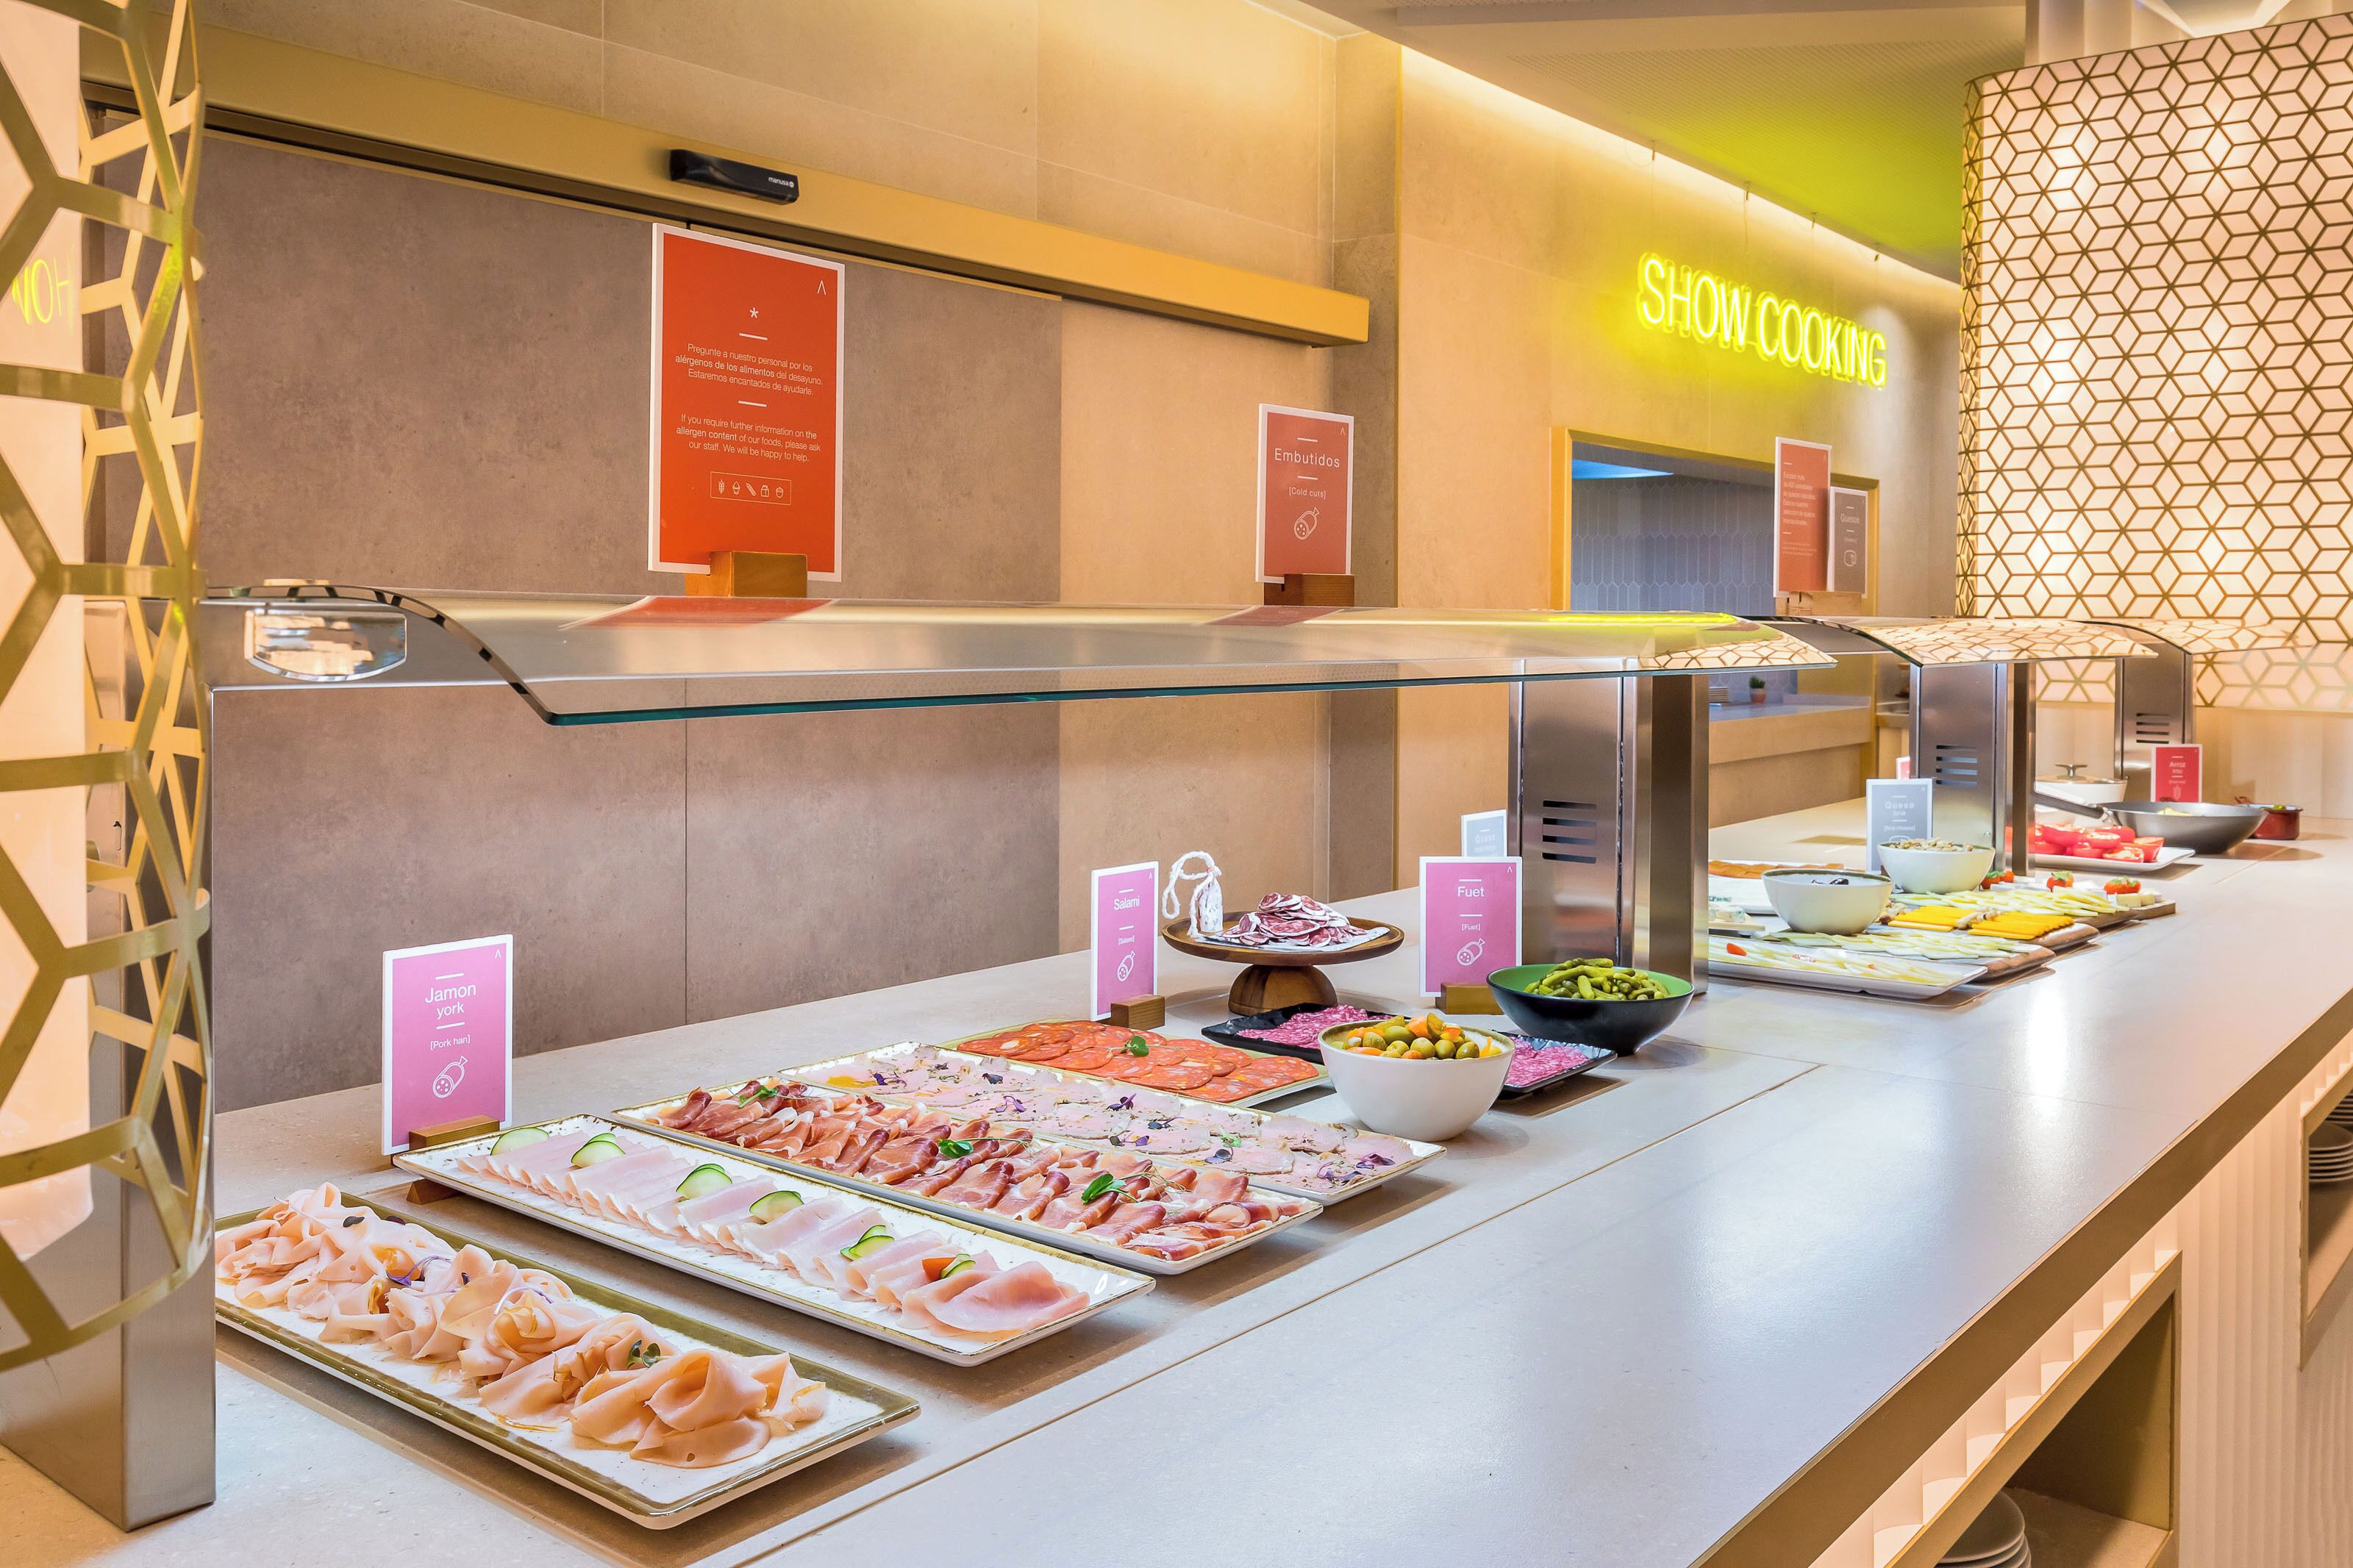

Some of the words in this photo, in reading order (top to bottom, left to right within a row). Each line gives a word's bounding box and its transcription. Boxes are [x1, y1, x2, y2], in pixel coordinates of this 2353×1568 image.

[768, 176, 789, 187] manusa
[1639, 255, 1752, 349] SHOW
[1757, 294, 1887, 387] COOKING
[688, 343, 721, 357] Pregunte
[729, 352, 757, 363] nuestro
[757, 357, 788, 368] personal
[789, 362, 801, 370] por
[802, 363, 813, 371] los
[675, 354, 713, 368] alérgenos
[714, 360, 725, 370] de
[726, 362, 738, 372] los
[739, 365, 775, 378] alimentos
[776, 370, 787, 379] del
[788, 373, 823, 385] desayuno.
[688, 368, 727, 382] Estaremos
[729, 376, 771, 389] encantados
[771, 382, 782, 390] de
[782, 384, 813, 395] ayudarle.
[681, 414, 686, 423] If
[688, 416, 701, 424] you
[703, 418, 729, 428] require
[729, 420, 754, 431] further
[754, 424, 793, 436] information
[805, 431, 817, 440] the
[676, 426, 707, 438] allergen
[708, 432, 738, 441] content
[738, 434, 746, 442] of
[748, 436, 760, 444] our
[761, 436, 783, 448] foods,
[785, 440, 807, 450] please
[688, 441, 701, 449] our
[703, 443, 721, 451] staff.
[722, 444, 735, 453] We
[736, 446, 749, 454] will
[749, 447, 760, 456] be
[760, 448, 783, 460] happy
[793, 452, 809, 463] help.
[1274, 448, 1340, 468] Embutidos
[1288, 486, 1307, 498] [Cold
[1309, 489, 1327, 500] cuts]
[1885, 801, 1915, 809] Queso
[1475, 834, 1496, 844] Queso
[1457, 885, 1485, 898] Fuet
[1113, 895, 1140, 911] Salami
[1461, 923, 1481, 931] [Fuet]
[425, 983, 476, 1004] Jamon
[436, 1002, 465, 1020] york
[430, 1038, 451, 1051] [Pork
[453, 1034, 471, 1045] han]
